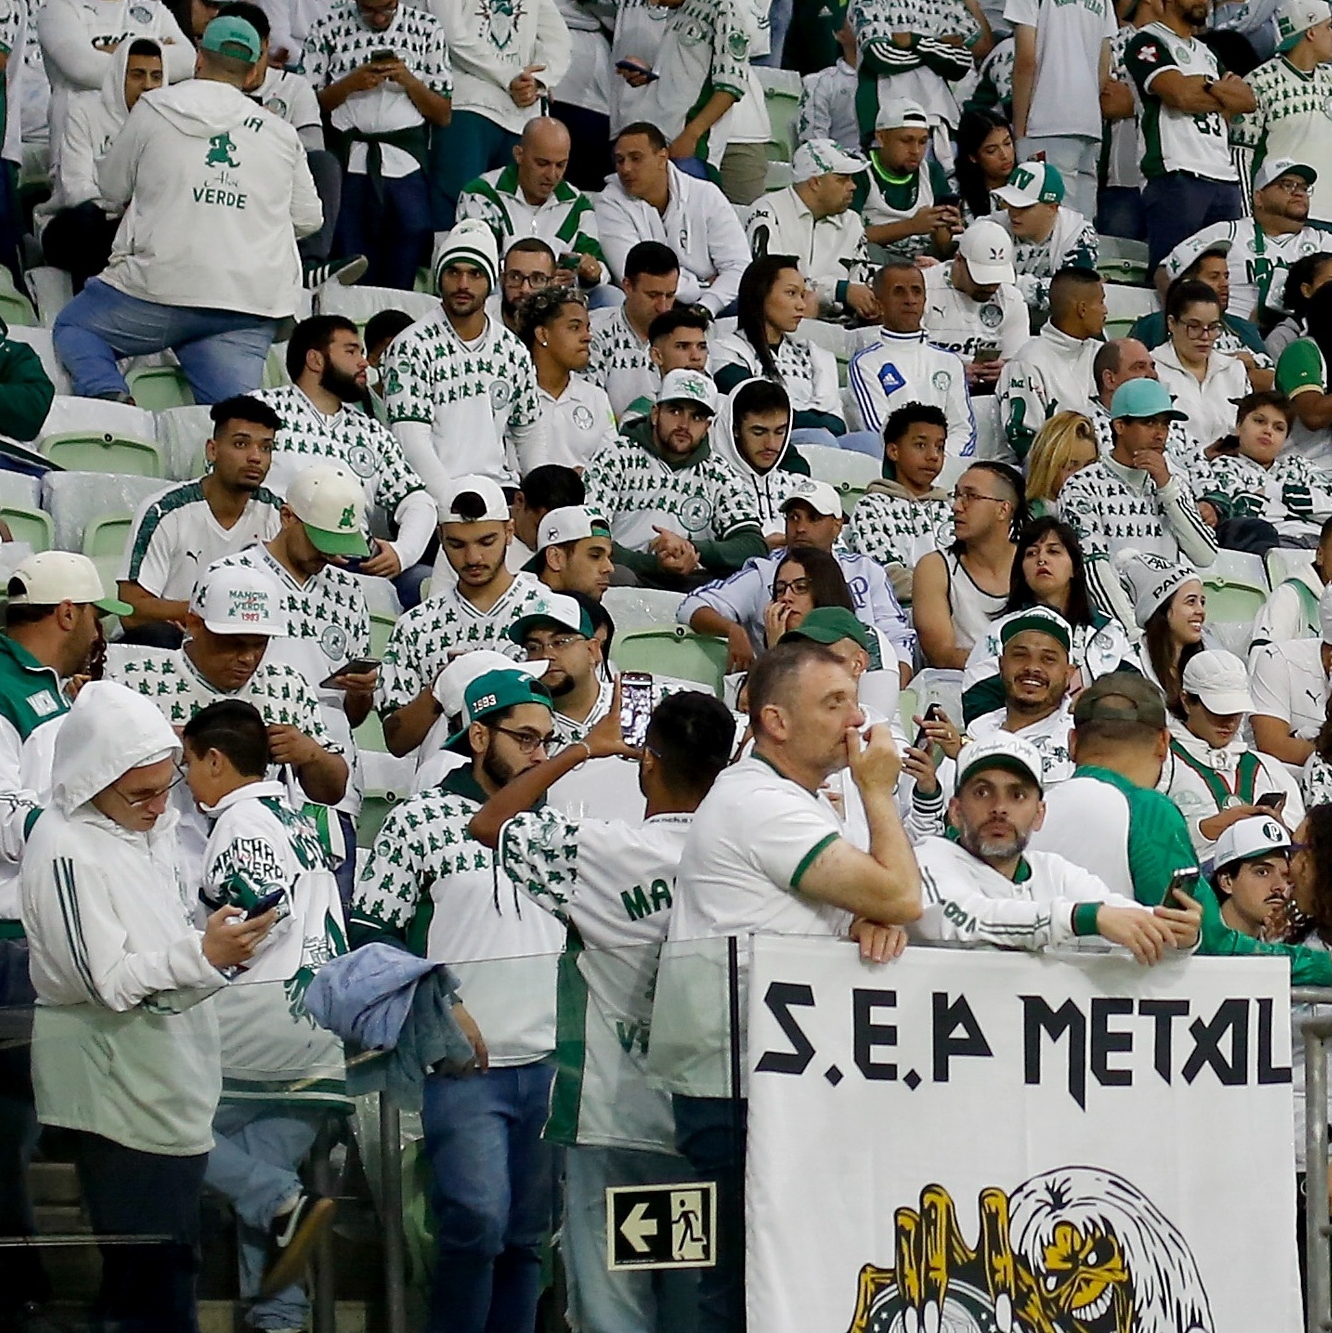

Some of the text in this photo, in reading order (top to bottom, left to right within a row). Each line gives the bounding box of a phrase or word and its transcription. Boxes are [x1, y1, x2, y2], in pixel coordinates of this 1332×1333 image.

[192, 188, 248, 210] VERDE
[229, 590, 269, 600] MANCHA
[234, 601, 266, 612] VERDE
[621, 878, 675, 922] MA
[753, 981, 1293, 1113] S.E.P METAL
